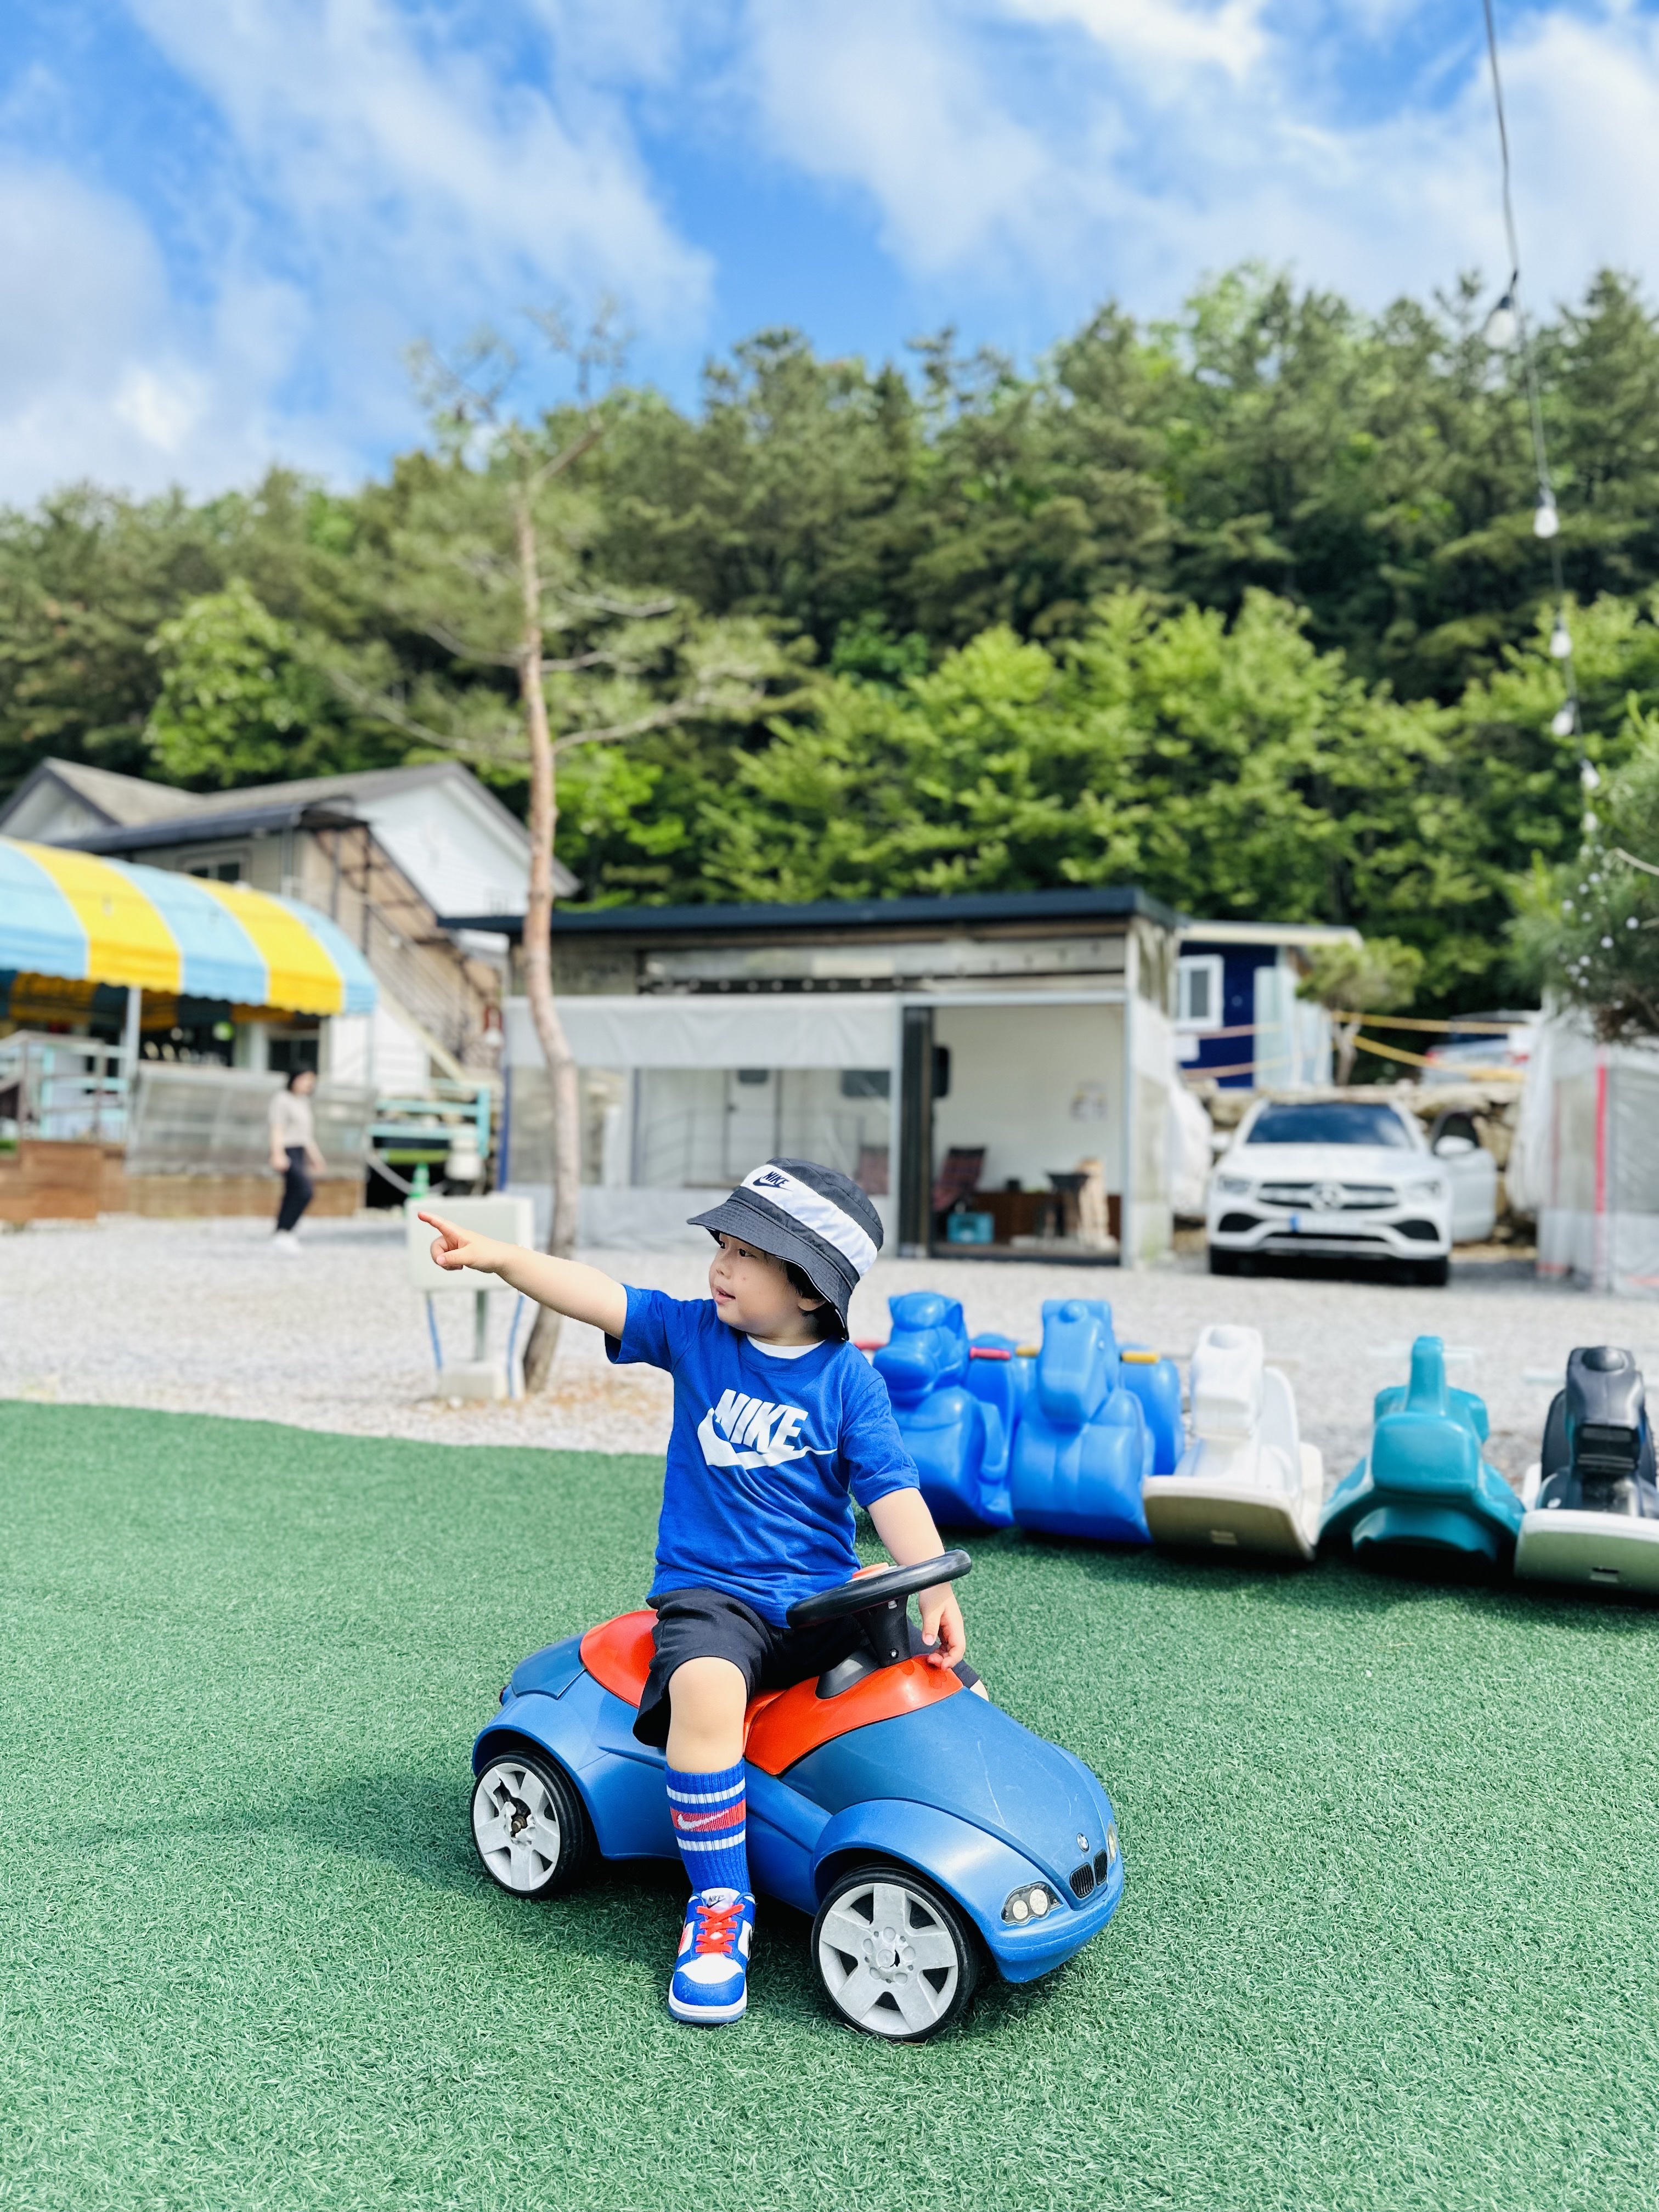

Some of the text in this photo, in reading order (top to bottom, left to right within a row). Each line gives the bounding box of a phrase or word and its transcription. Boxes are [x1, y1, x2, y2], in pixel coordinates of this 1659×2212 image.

[762, 1171, 790, 1186] NIKE
[714, 1388, 809, 1454] NIKE
[708, 1894, 725, 1903] NIKE
